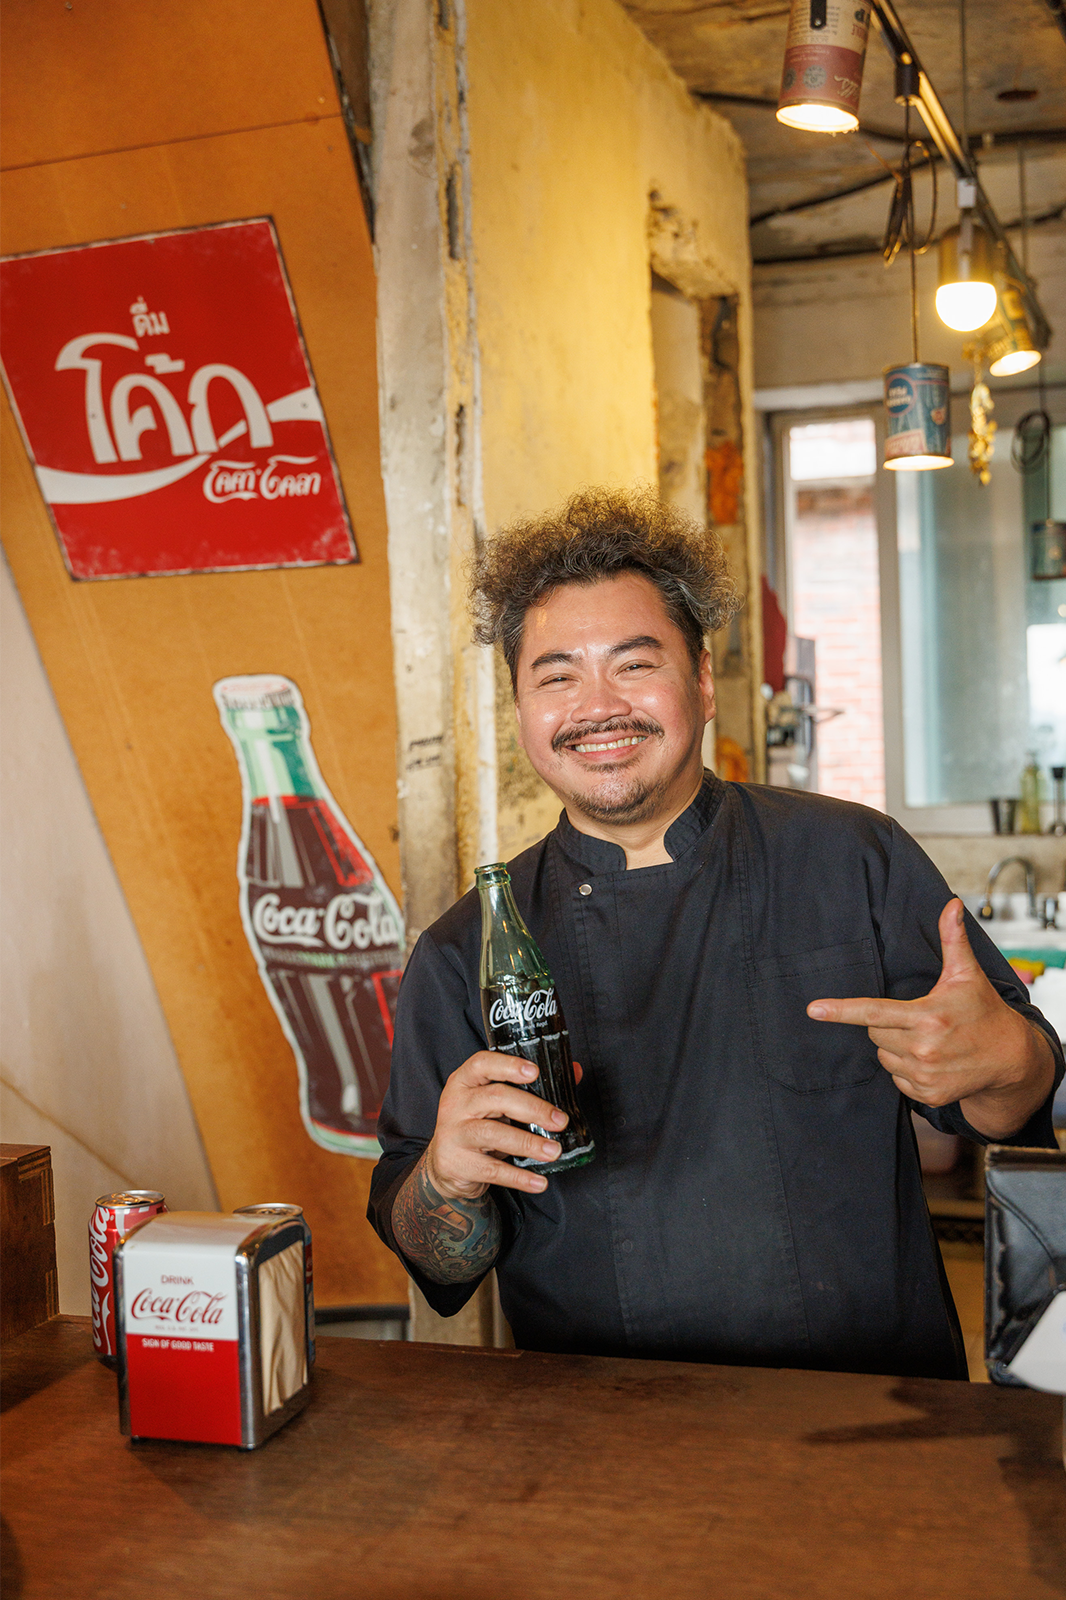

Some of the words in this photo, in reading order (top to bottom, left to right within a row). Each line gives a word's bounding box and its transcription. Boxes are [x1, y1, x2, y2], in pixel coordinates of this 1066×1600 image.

[130, 295, 170, 337] ดื่ม
[252, 892, 400, 950] Coca-Cola
[489, 987, 558, 1028] Coca-Cola
[161, 1274, 194, 1285] DRINK
[131, 1287, 228, 1324] Coca-Cola
[142, 1338, 159, 1348] SIGN
[161, 1339, 170, 1349] OF
[171, 1339, 192, 1351] GOOD
[193, 1341, 214, 1352] TASTE
